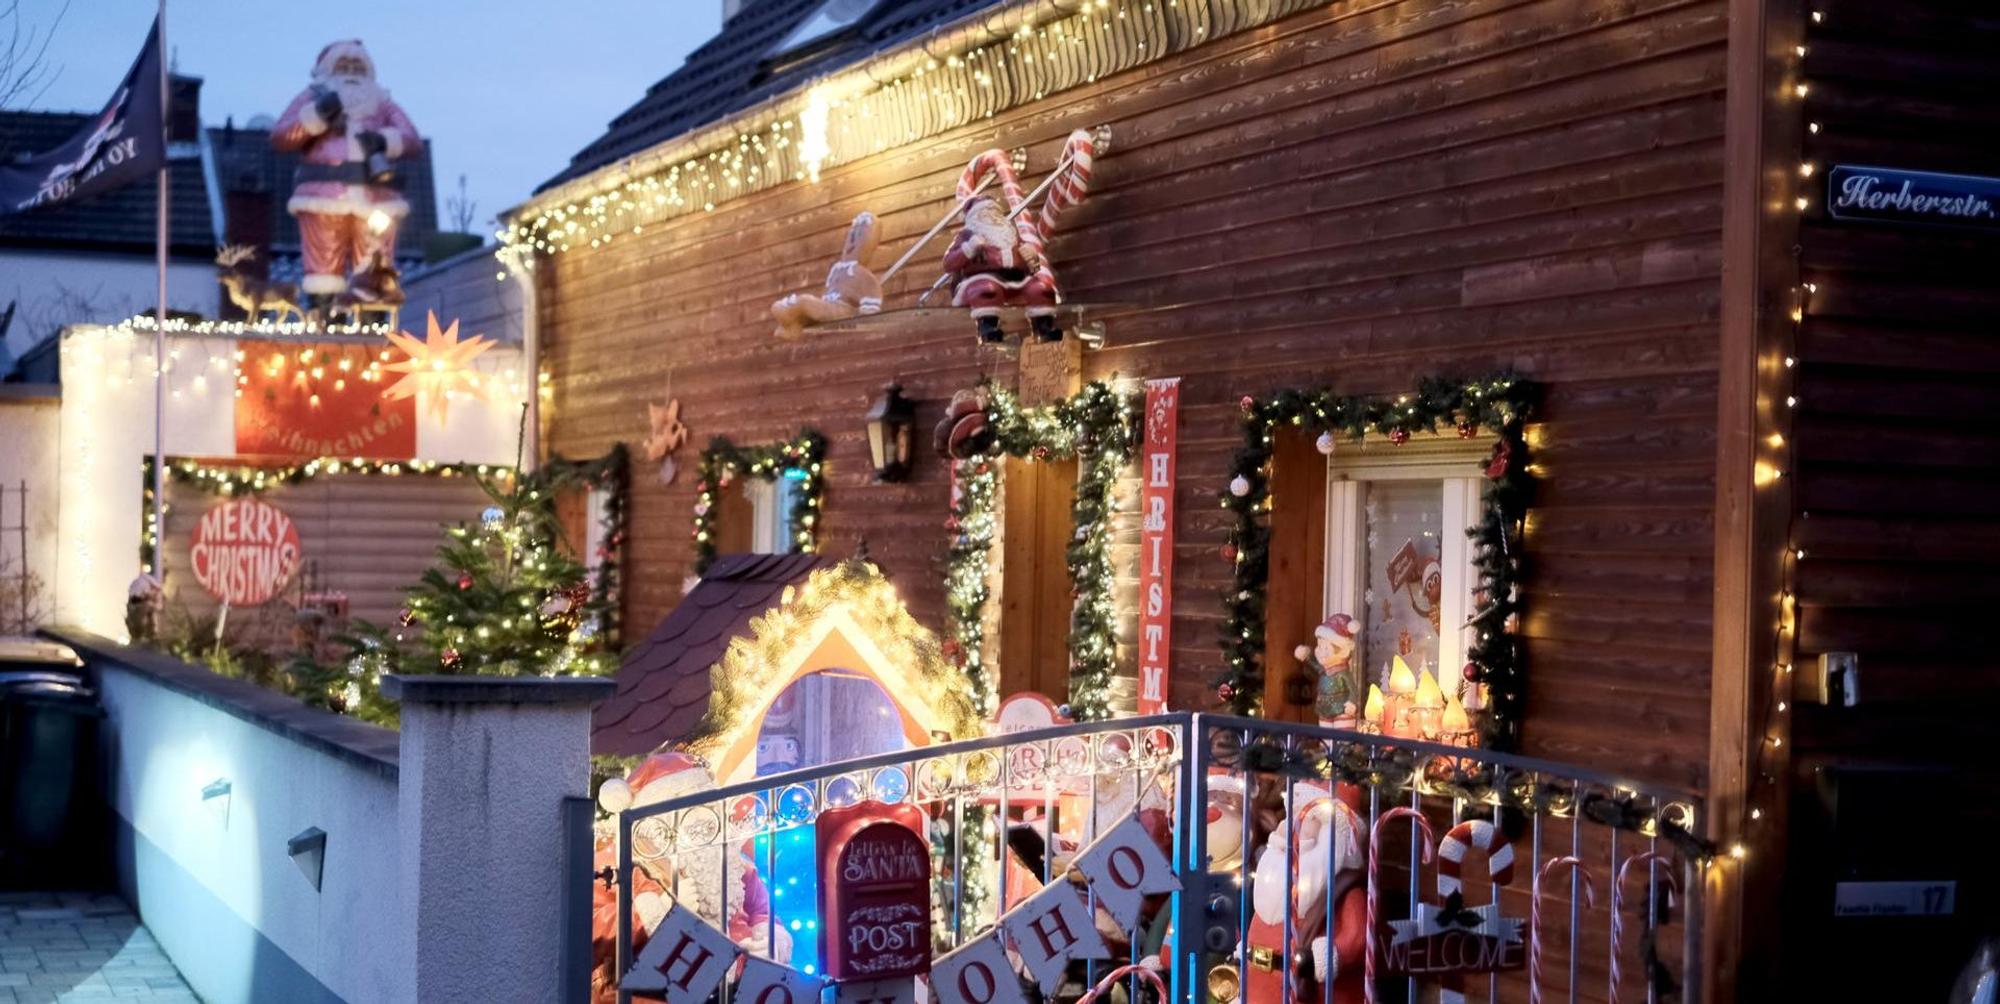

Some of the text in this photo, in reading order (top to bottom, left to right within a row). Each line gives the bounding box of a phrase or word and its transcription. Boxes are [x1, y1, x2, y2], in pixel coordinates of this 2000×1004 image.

[1837, 175, 1995, 219] Herberzstr.
[250, 411, 404, 456] eihnachten
[200, 499, 291, 547] MERRY
[190, 542, 297, 603] CHRISTMAS
[844, 855, 922, 882] SANTA
[1924, 886, 1947, 913] 17
[848, 921, 922, 954] POST
[1380, 933, 1525, 972] WELCOME
